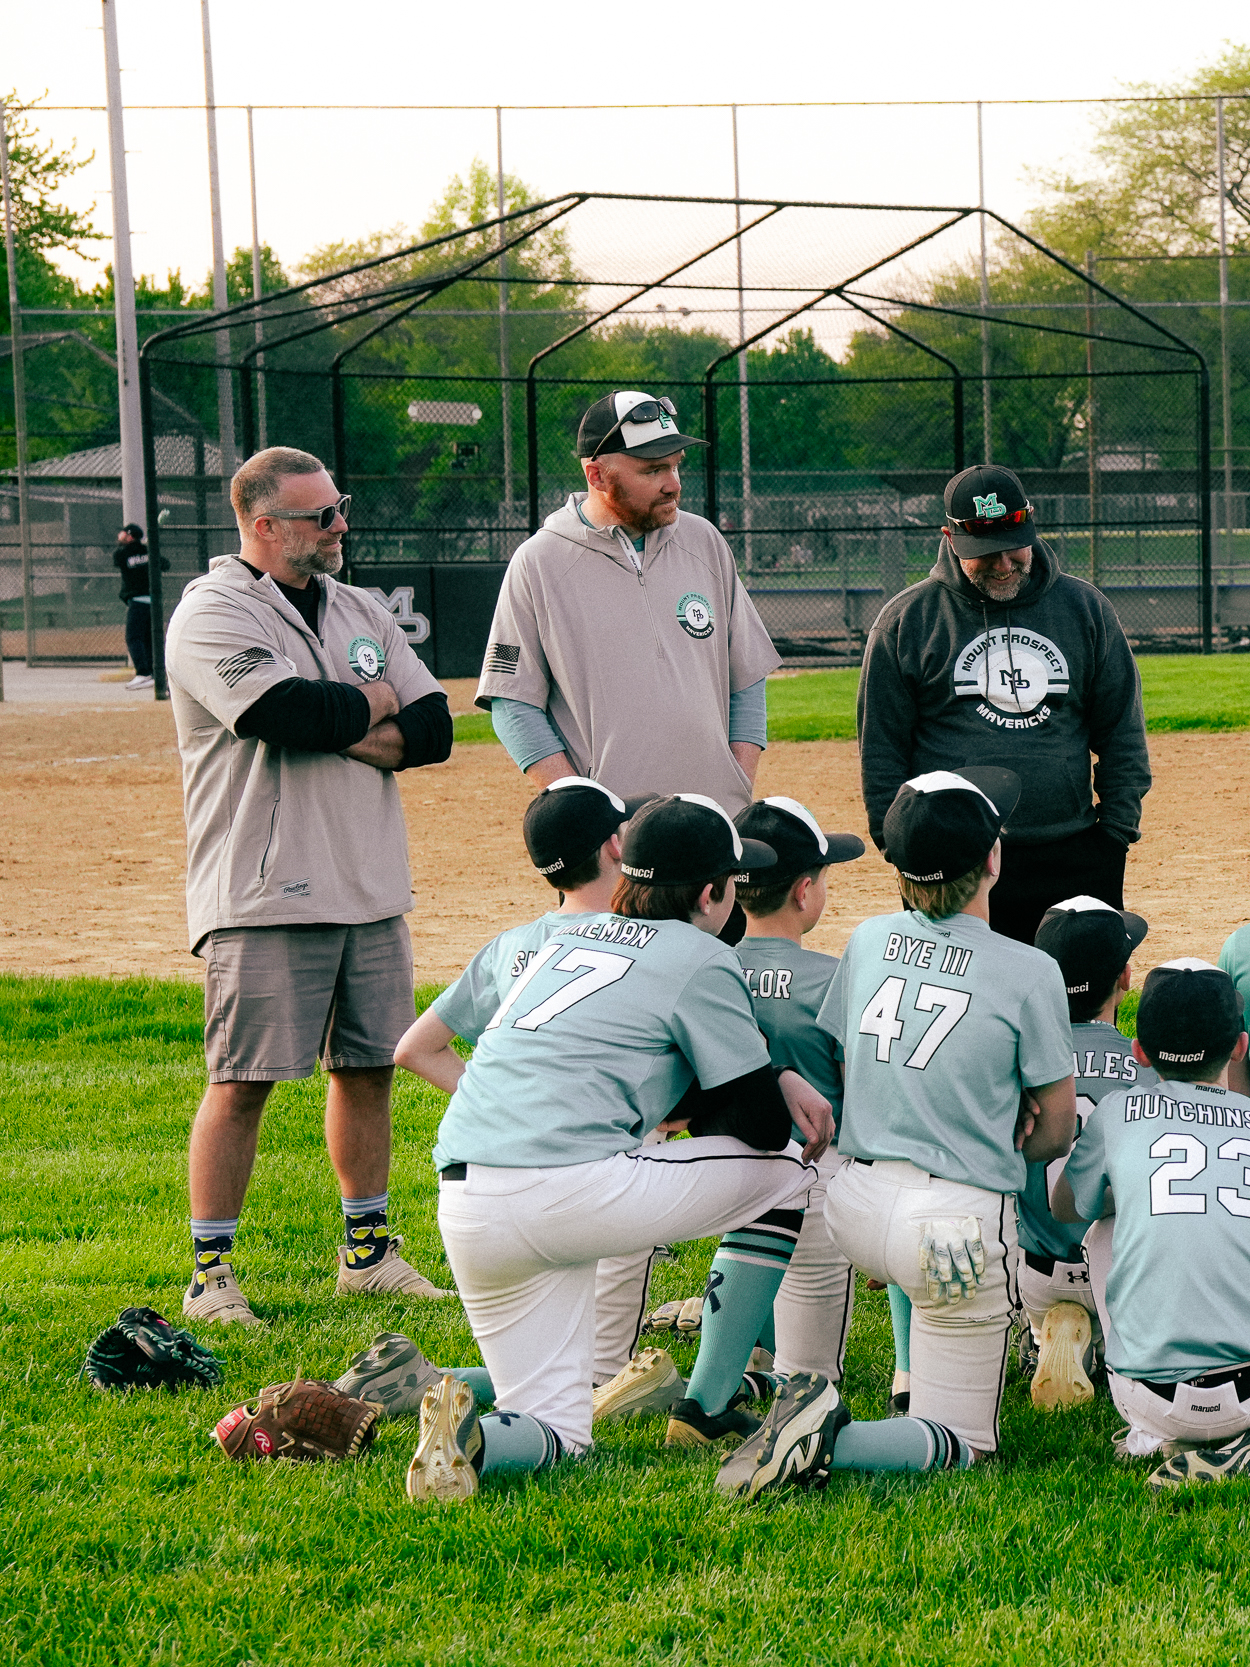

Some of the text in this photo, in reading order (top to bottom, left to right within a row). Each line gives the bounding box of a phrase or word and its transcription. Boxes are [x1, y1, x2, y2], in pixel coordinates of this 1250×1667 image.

[962, 634, 1063, 674] MOUNT PROSPECT
[975, 703, 1052, 730] MAVERICKS
[883, 932, 937, 970] BYE
[484, 943, 637, 1032] 17
[859, 975, 973, 1071] 47
[1158, 1050, 1205, 1063] marucci
[1195, 1084, 1227, 1096] marucci
[1190, 1403, 1221, 1413] marucci
